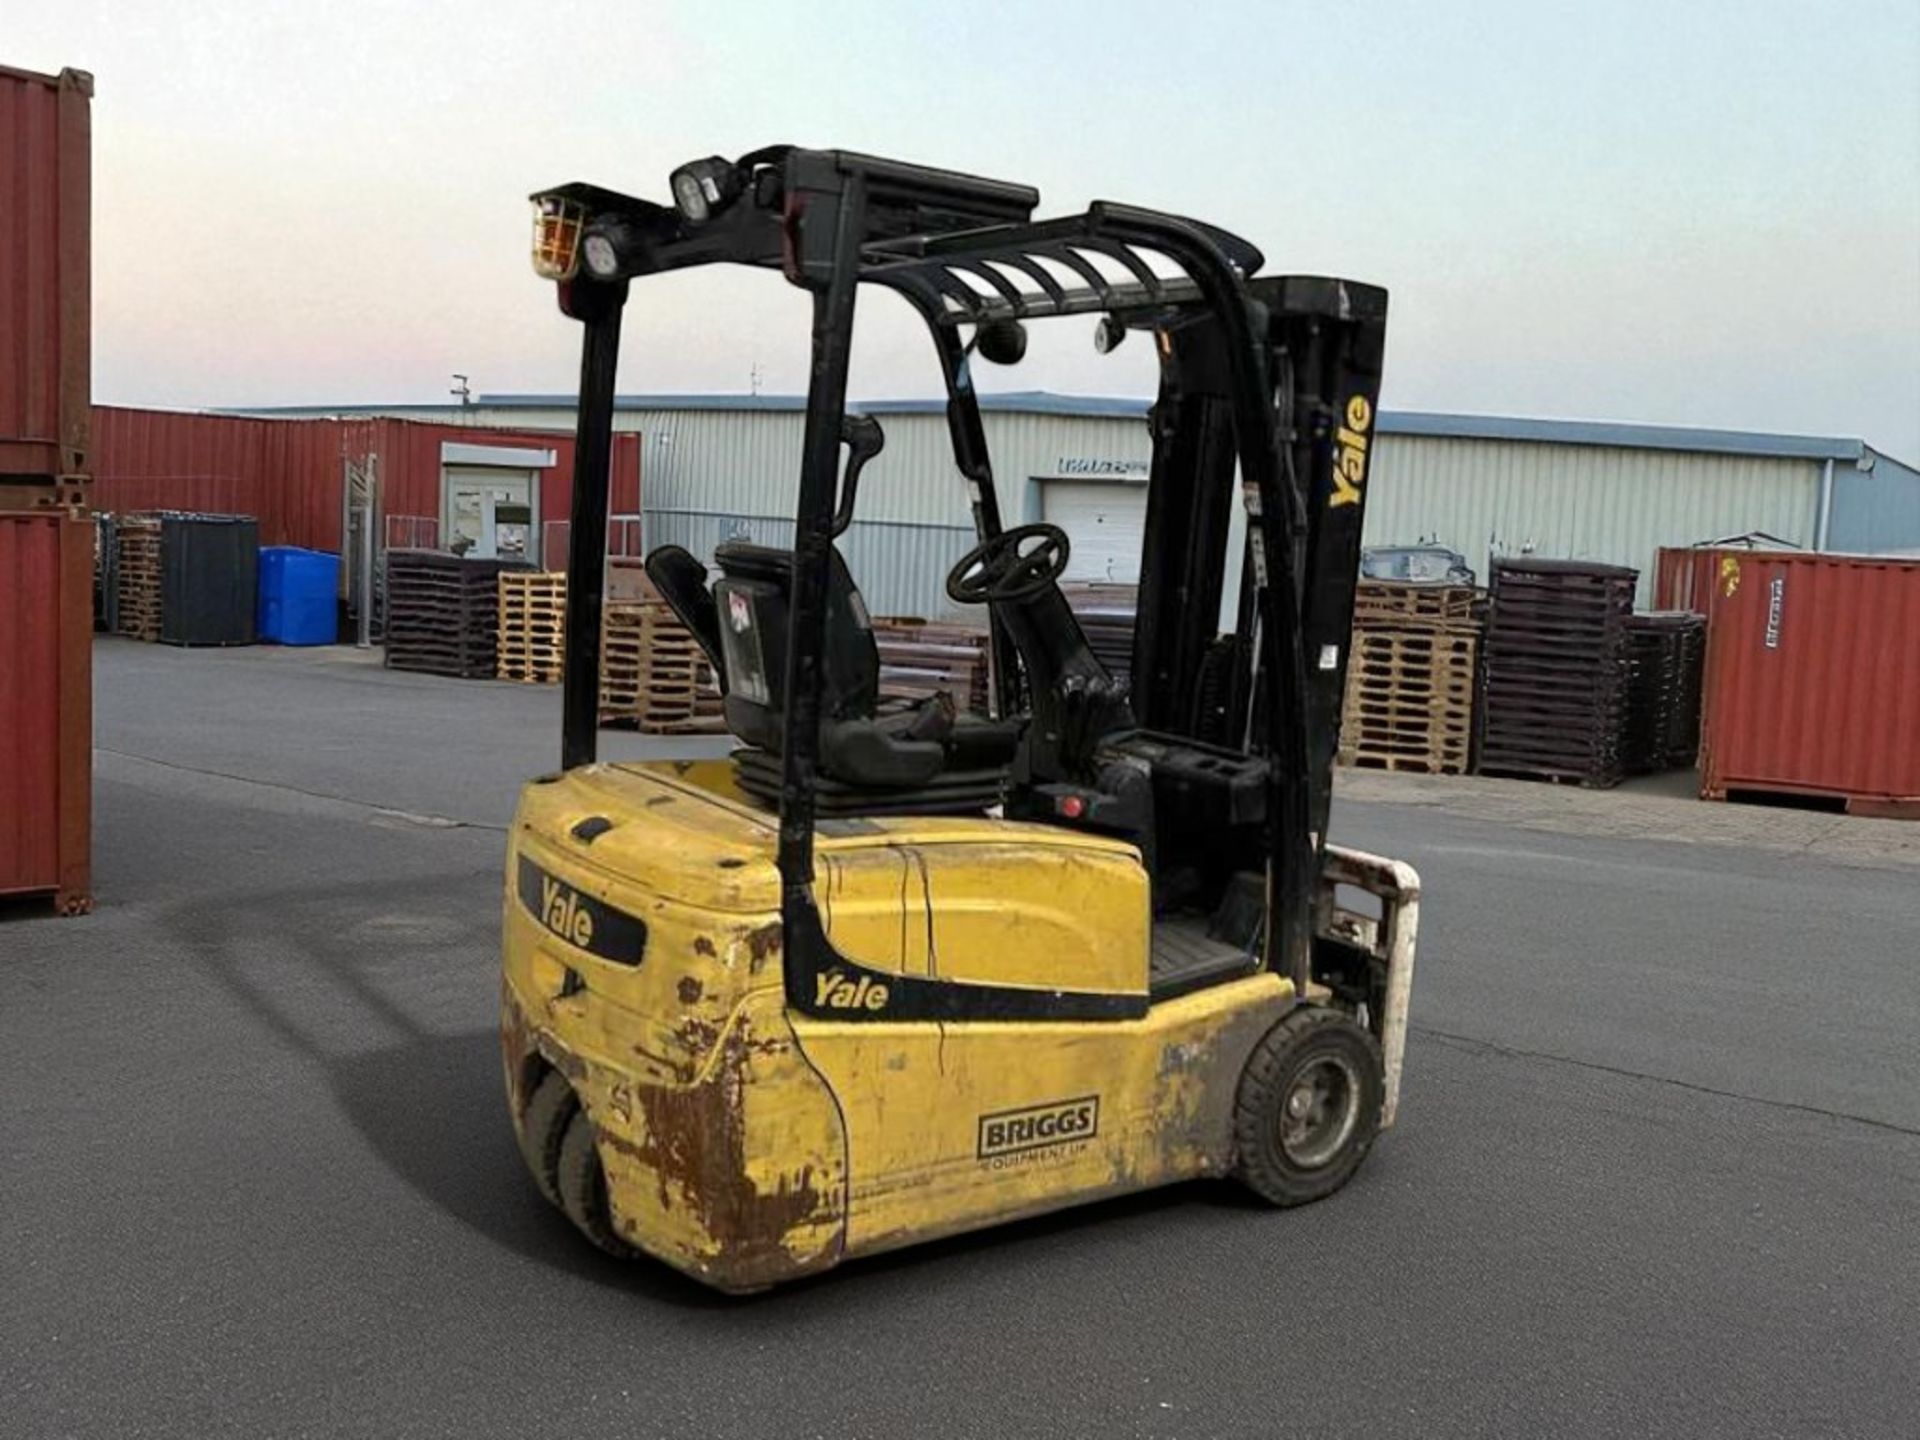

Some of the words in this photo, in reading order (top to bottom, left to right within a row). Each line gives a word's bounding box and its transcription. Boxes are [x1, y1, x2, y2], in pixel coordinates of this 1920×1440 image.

[1329, 395, 1370, 506] Yale
[541, 876, 593, 946] Yale
[815, 973, 889, 1010] Yale
[987, 1106, 1091, 1147] BRIGGS
